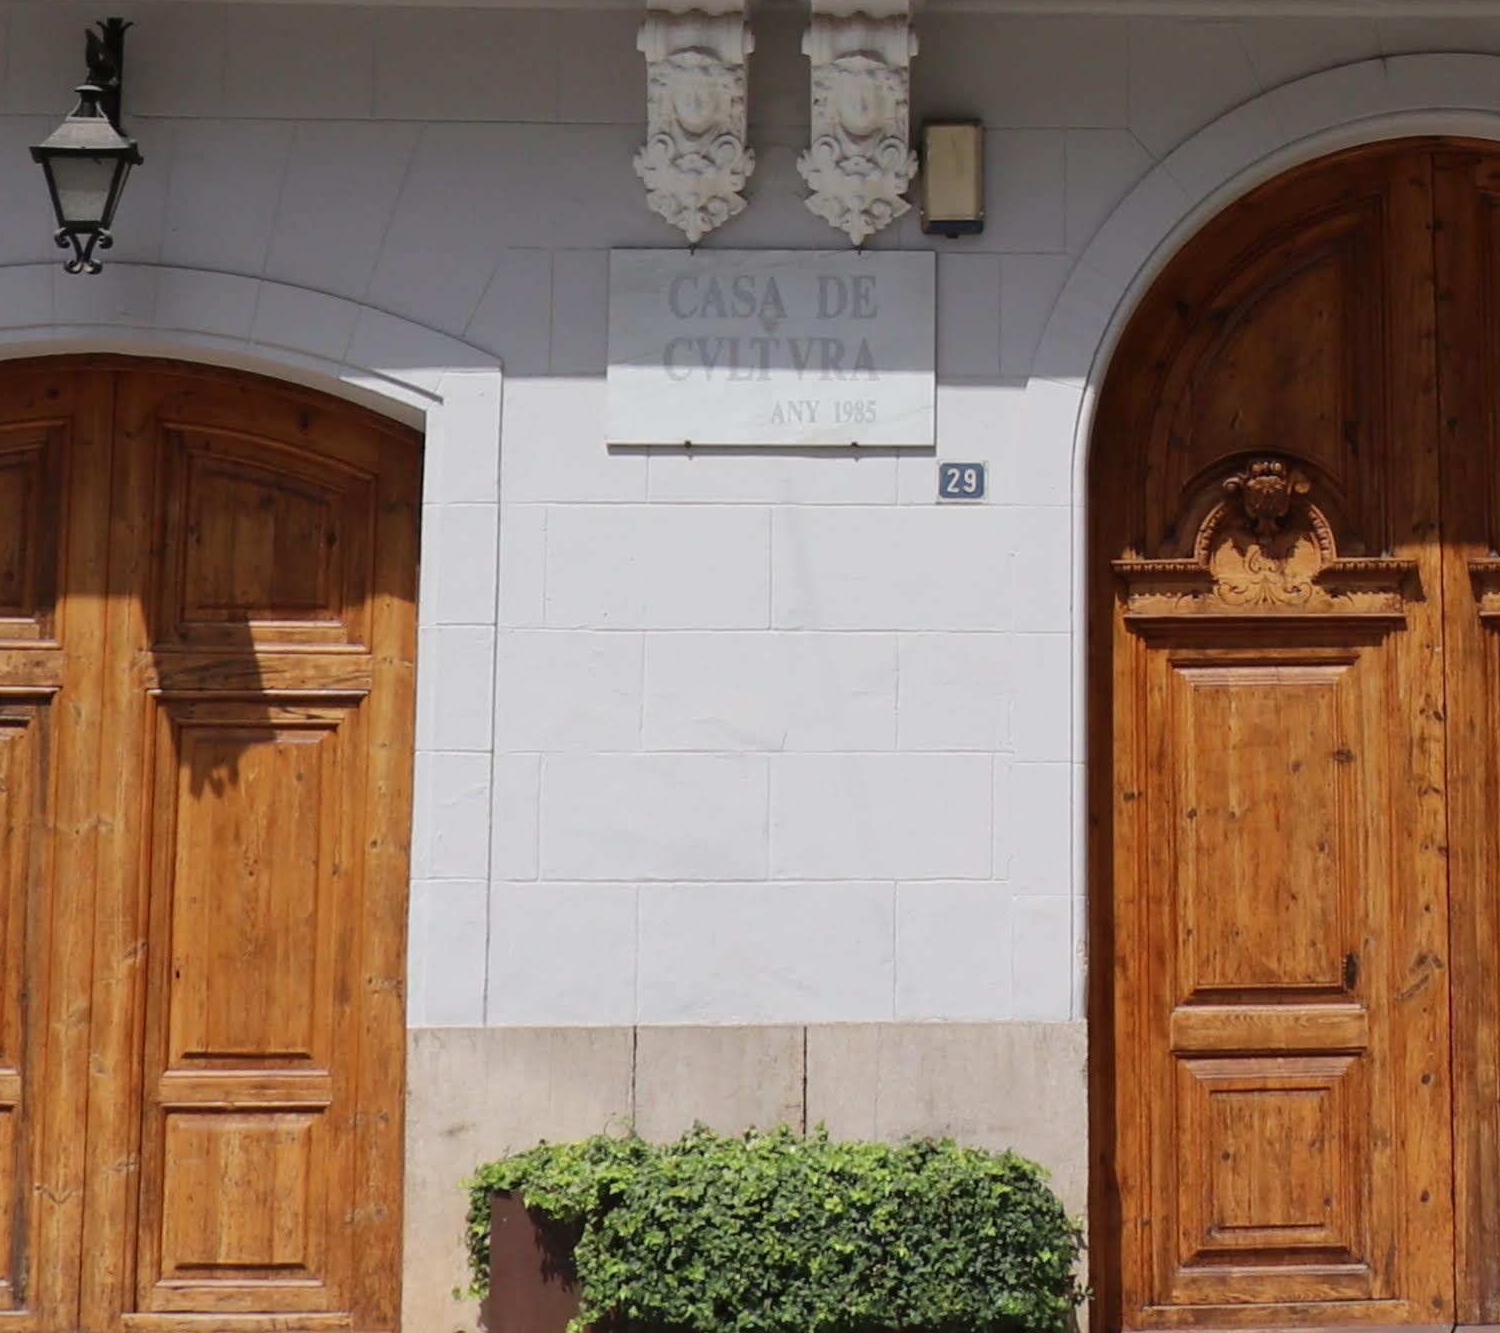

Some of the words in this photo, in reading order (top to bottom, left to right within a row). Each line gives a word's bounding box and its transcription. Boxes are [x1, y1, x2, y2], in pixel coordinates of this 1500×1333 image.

[668, 275, 788, 320] CASA
[816, 275, 879, 320] DE
[662, 336, 882, 382] CVLTVRA
[769, 399, 821, 424] ANY
[833, 399, 877, 424] 1985
[946, 468, 977, 494] 29
